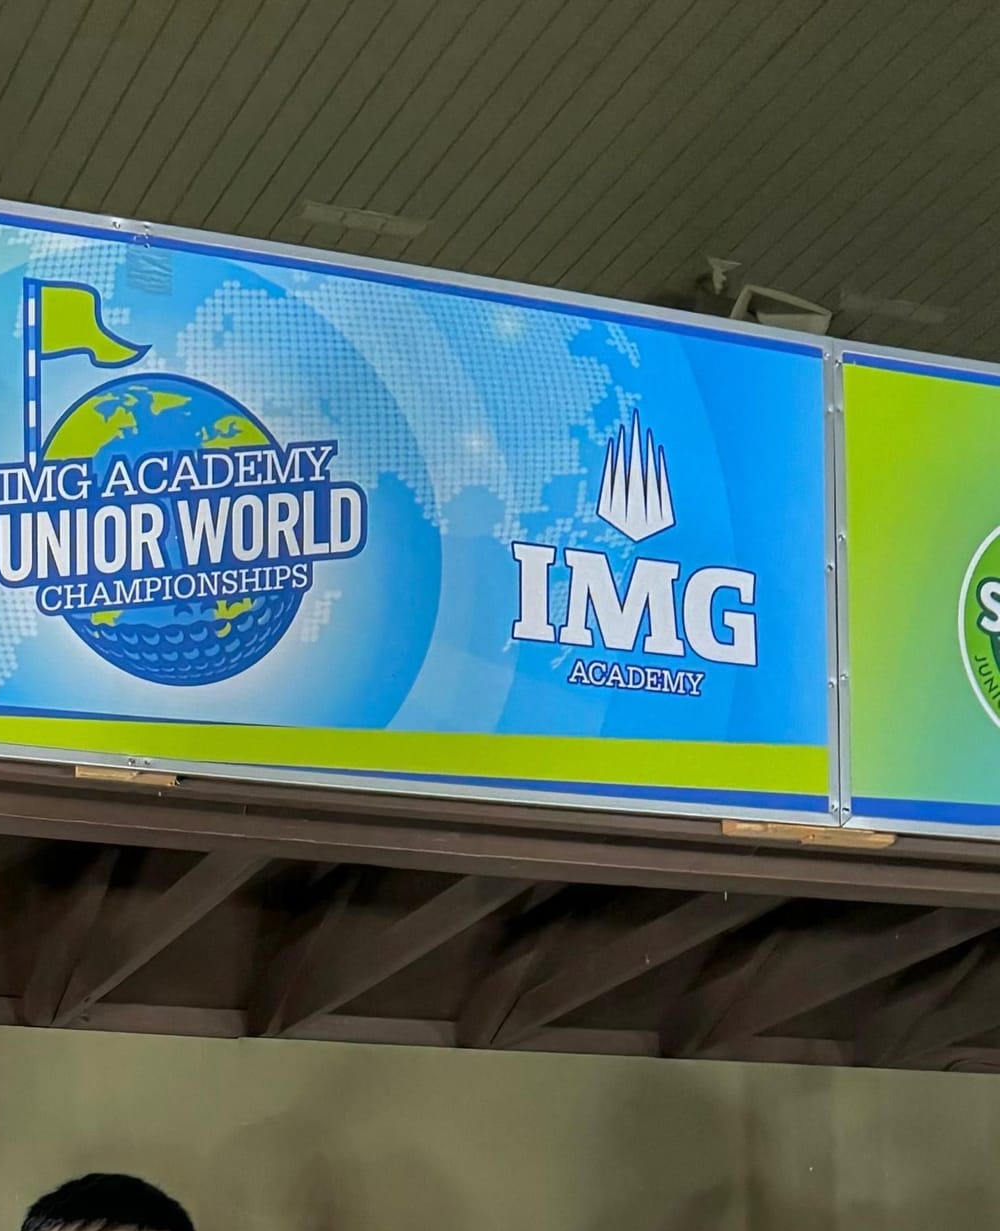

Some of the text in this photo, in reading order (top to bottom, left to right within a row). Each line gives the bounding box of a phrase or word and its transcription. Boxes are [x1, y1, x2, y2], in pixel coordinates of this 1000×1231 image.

[101, 446, 333, 497] ACADEMY
[174, 488, 362, 566] WORLD
[40, 564, 309, 612] CHAMPIONSHIPS
[511, 541, 757, 667] IMG
[569, 660, 704, 696] ACADEMY
